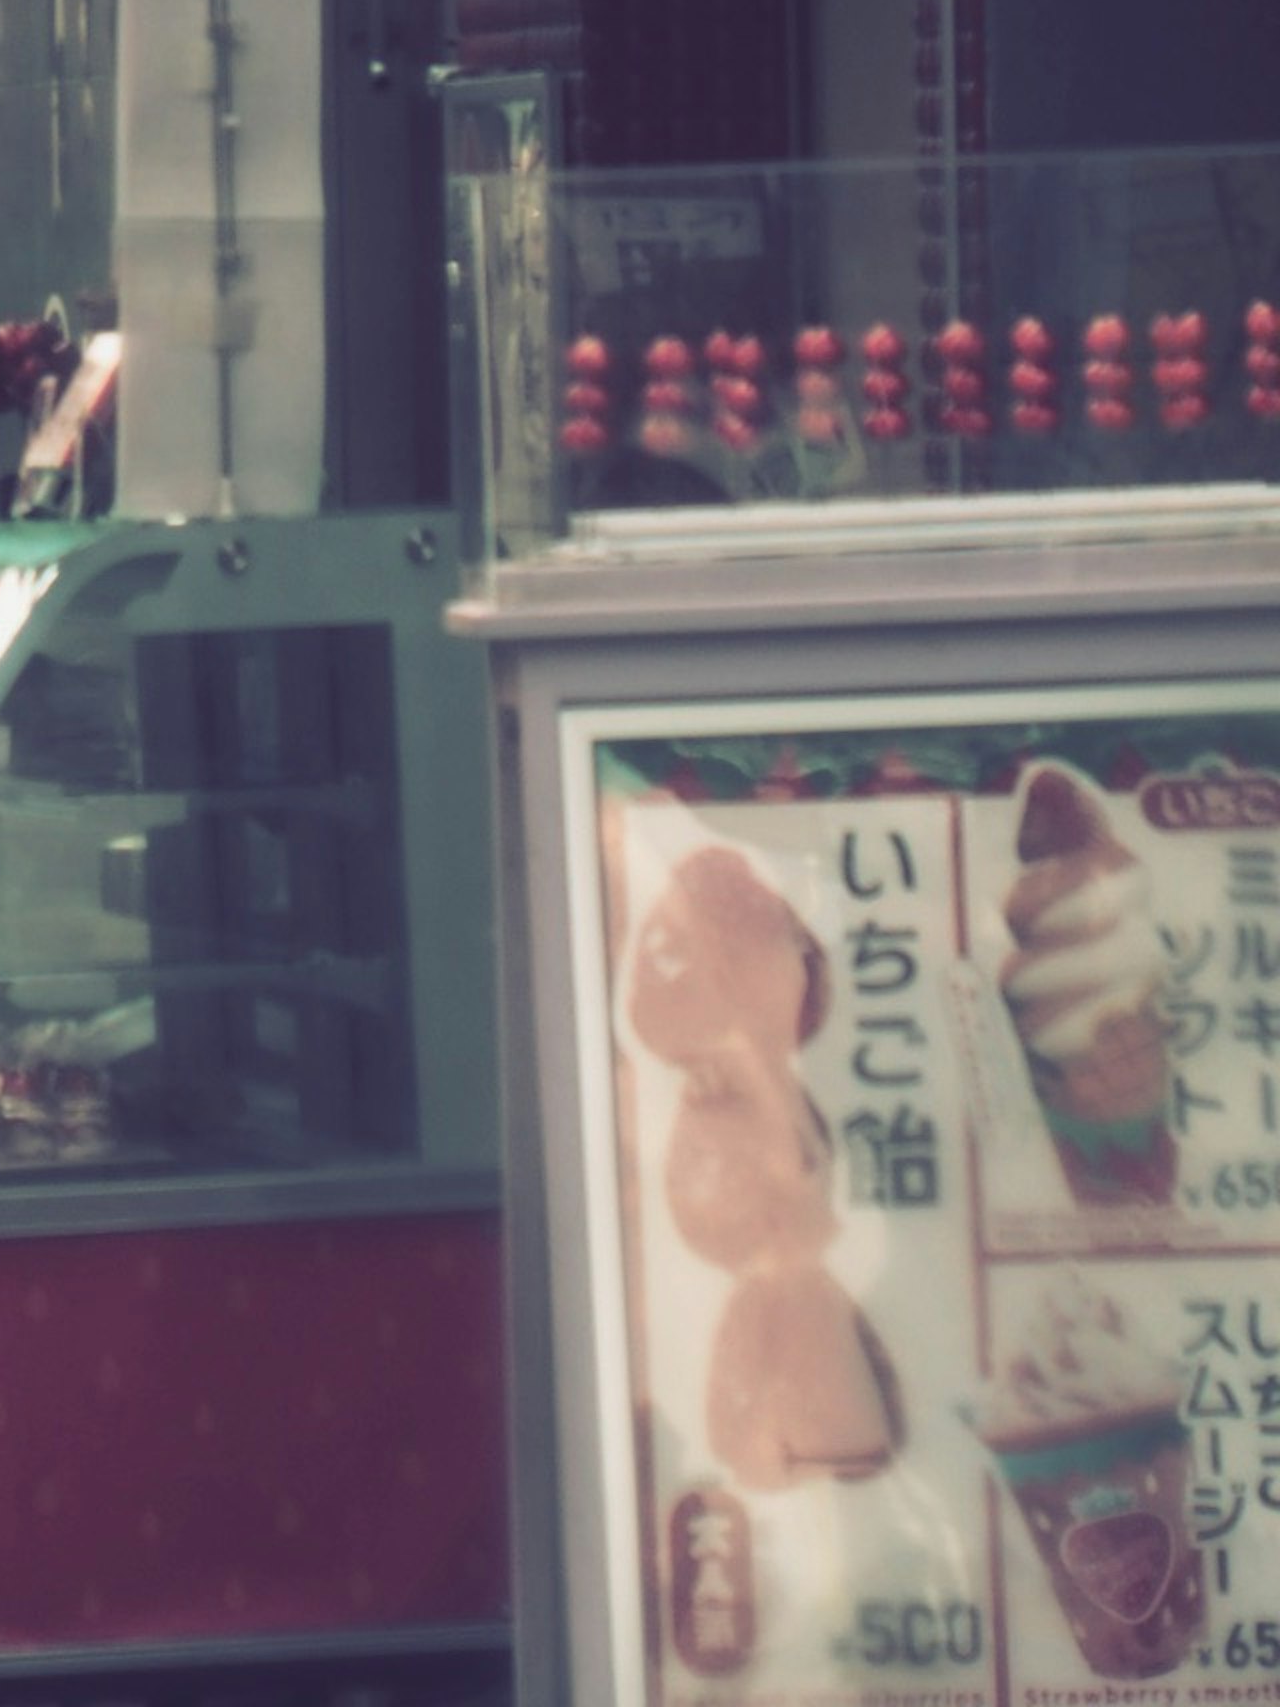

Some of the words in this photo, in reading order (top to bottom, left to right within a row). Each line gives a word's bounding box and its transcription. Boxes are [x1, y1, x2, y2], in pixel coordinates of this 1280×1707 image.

[841, 828, 941, 1211] いちご飴
[1154, 923, 1227, 1135] ソフト
[1183, 1300, 1246, 1597] スムージー
